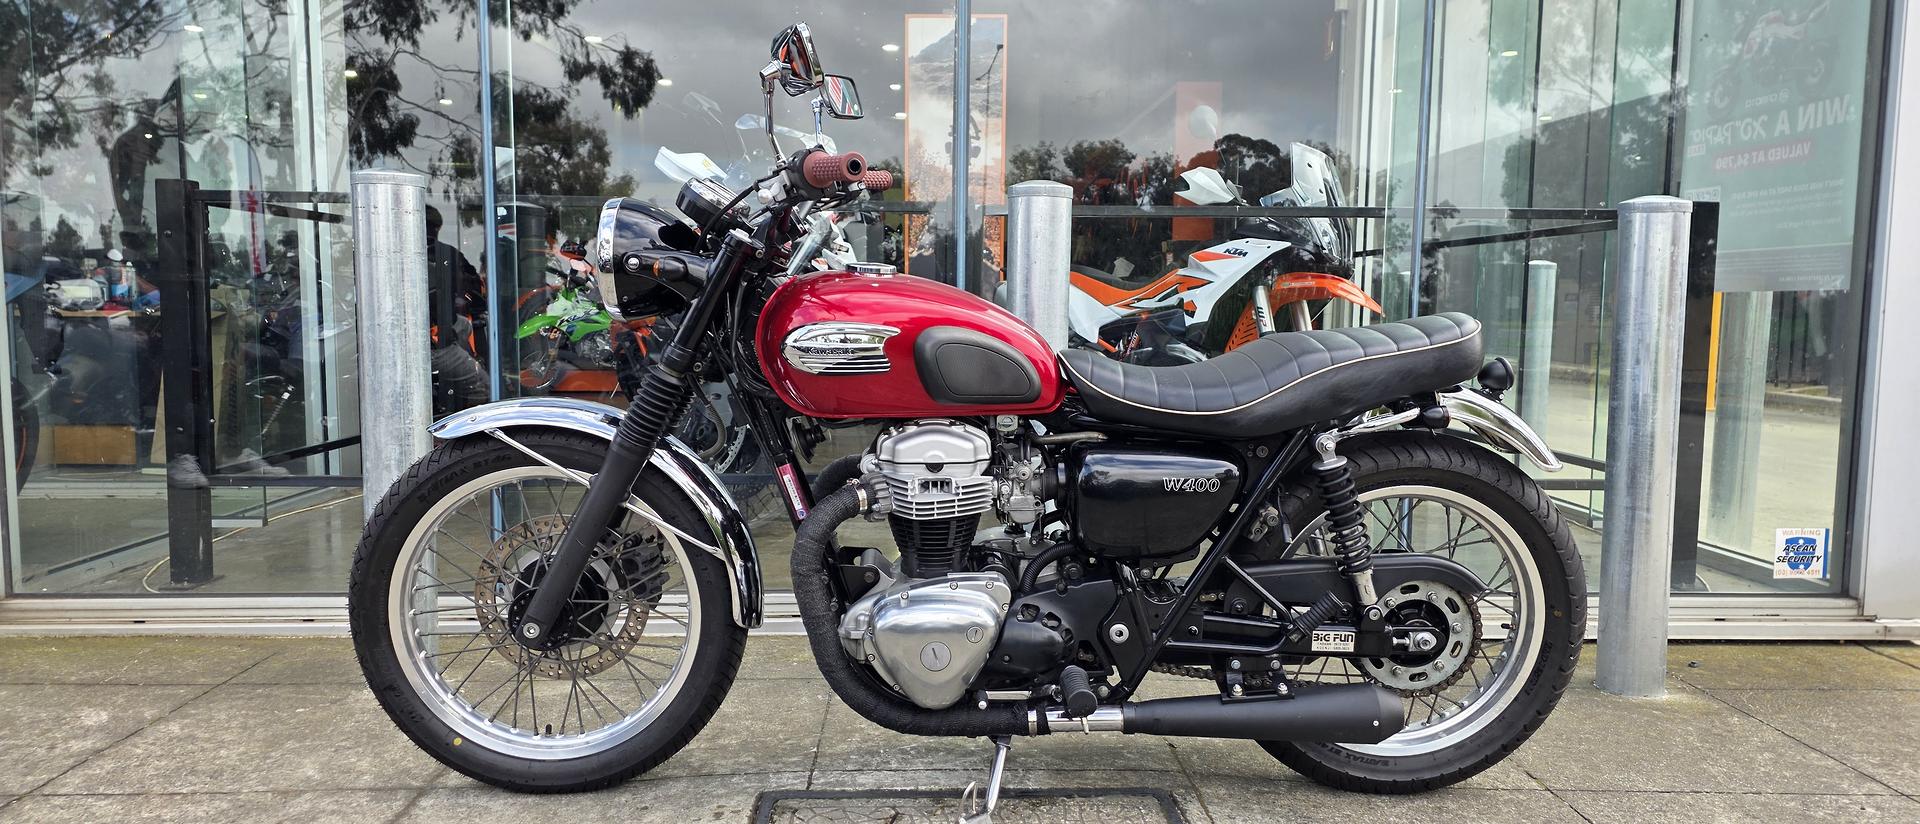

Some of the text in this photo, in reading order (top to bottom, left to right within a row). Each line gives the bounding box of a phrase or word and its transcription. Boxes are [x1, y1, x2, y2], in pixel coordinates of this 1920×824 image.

[1223, 247, 1248, 258] KTM
[1162, 477, 1221, 493] W400
[1782, 529, 1822, 537] WARNING
[1782, 544, 1818, 552] ASCAN
[1775, 555, 1823, 563] SECURITY
[1333, 633, 1354, 643] FUN
